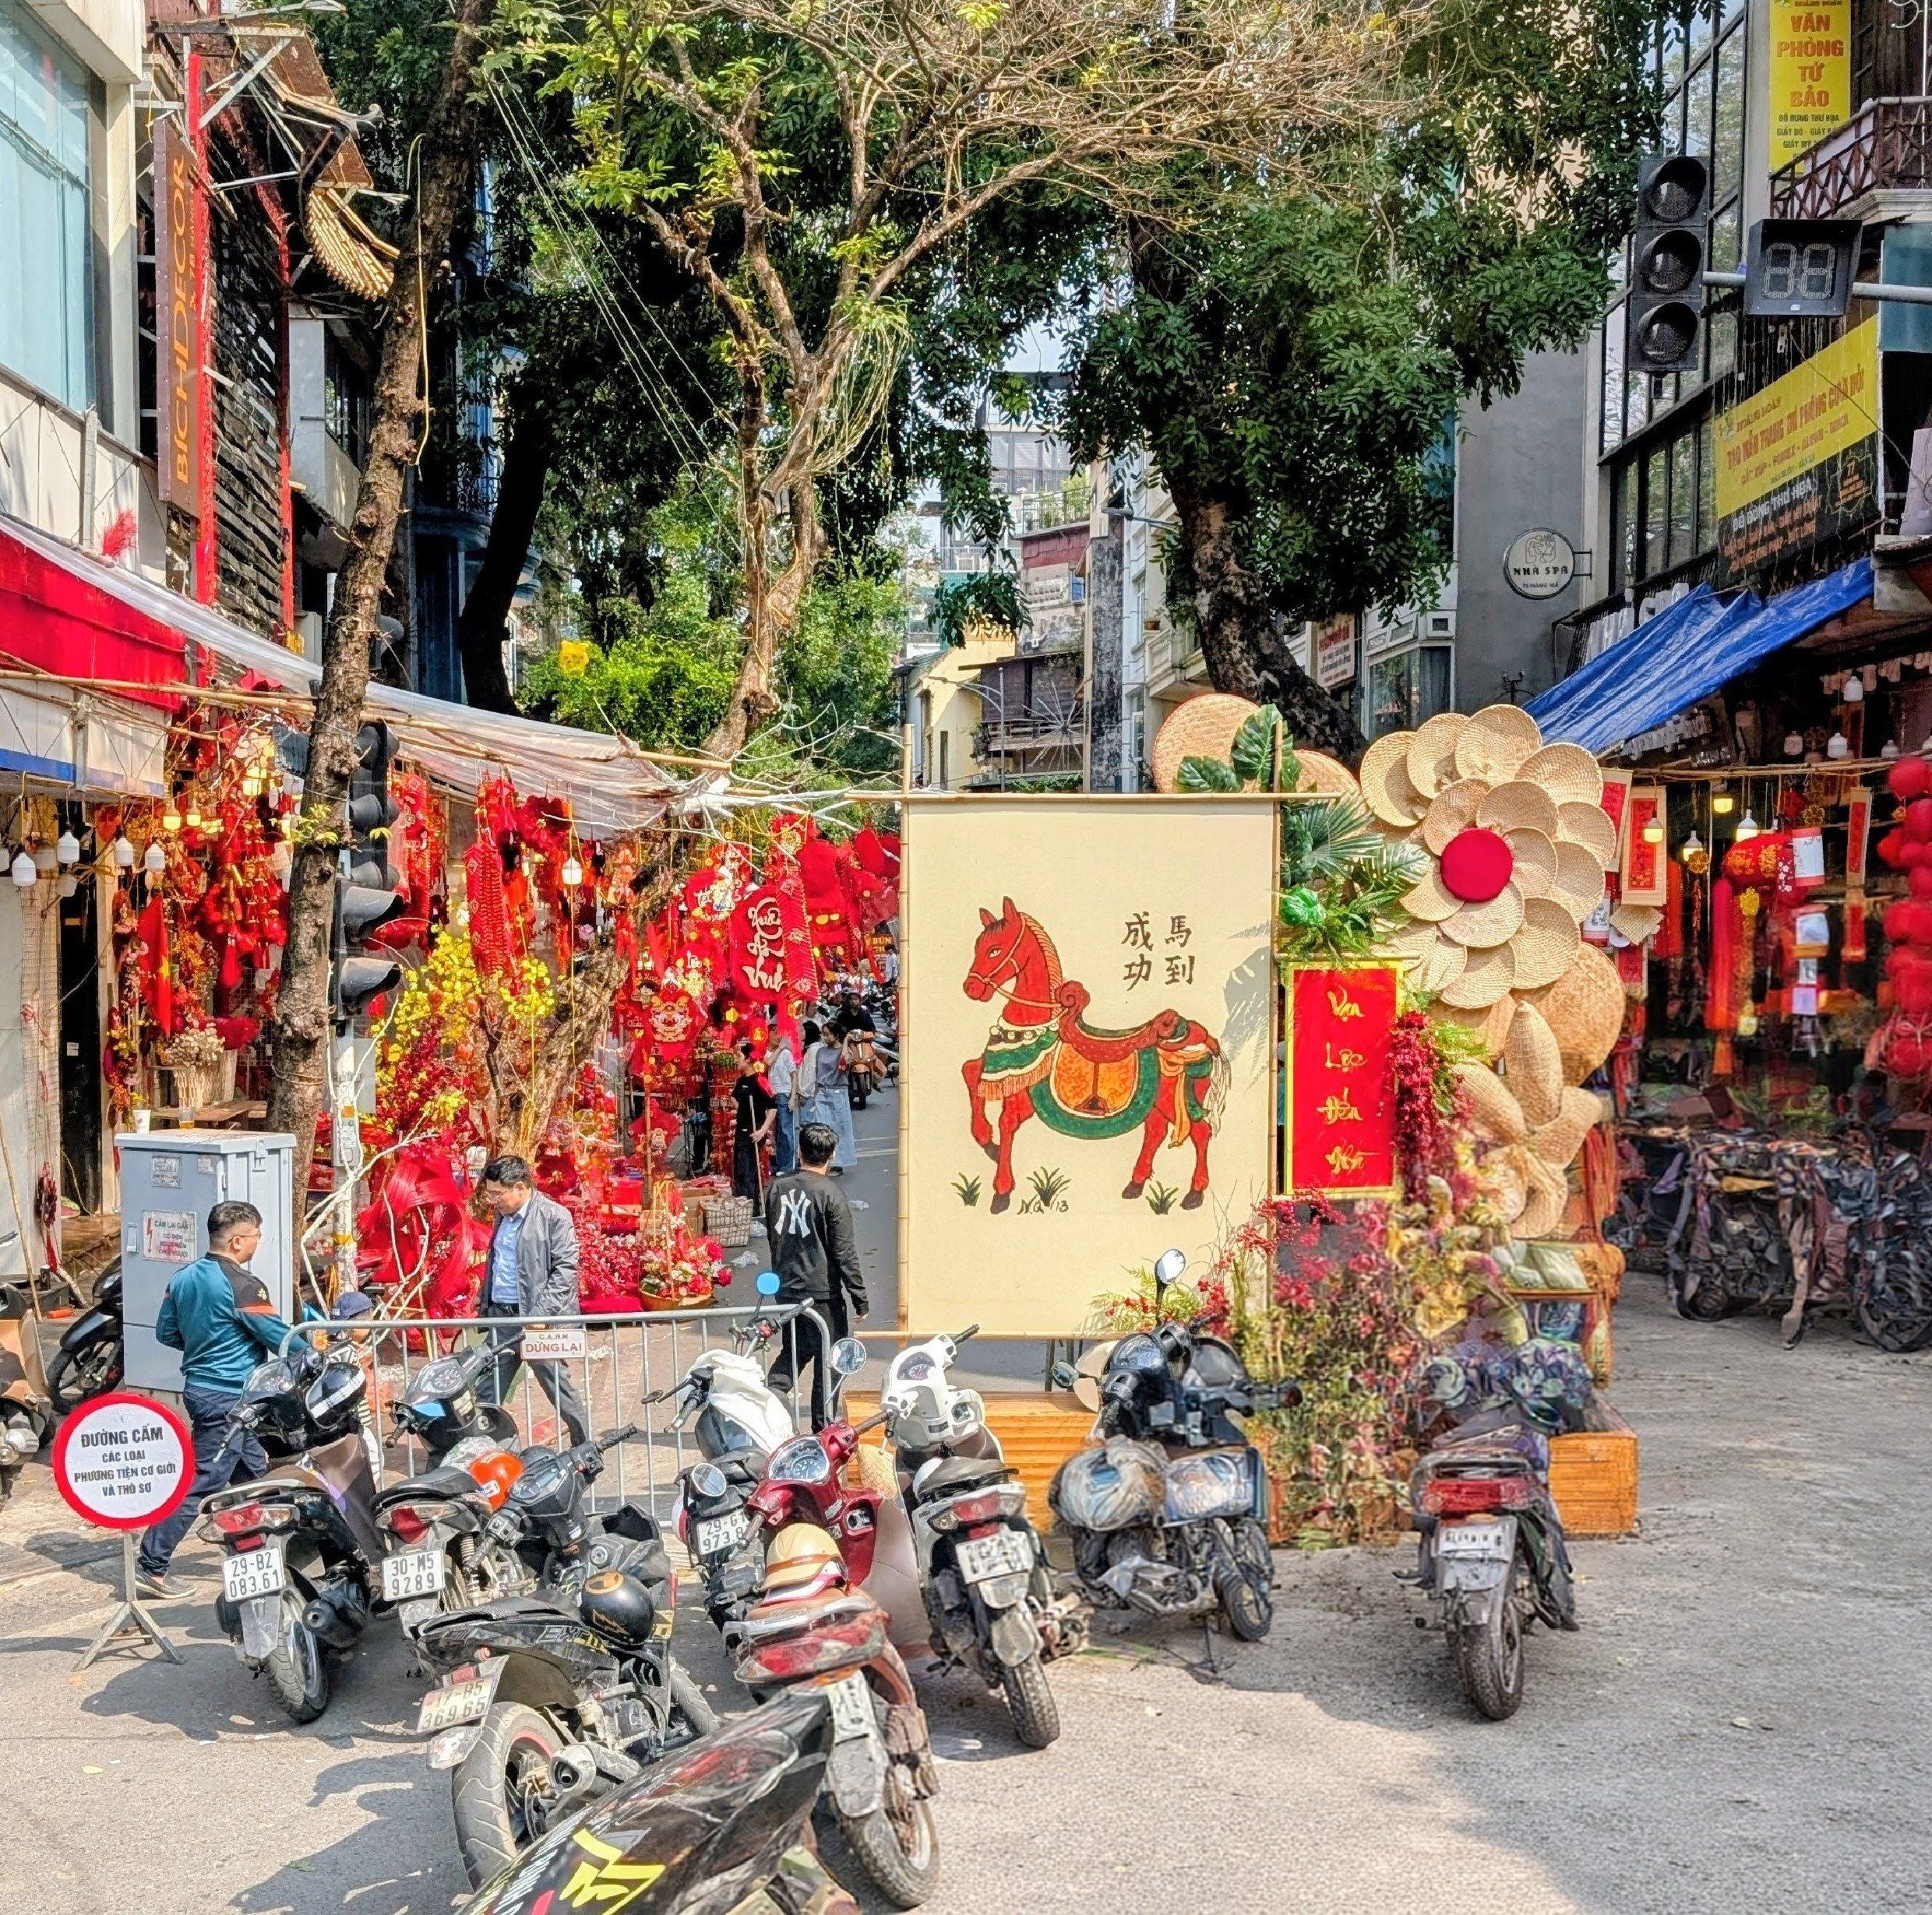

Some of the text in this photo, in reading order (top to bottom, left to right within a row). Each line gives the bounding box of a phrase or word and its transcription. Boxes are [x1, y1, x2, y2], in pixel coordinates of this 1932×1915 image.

[1790, 12, 1831, 33] VĂN
[1790, 85, 1830, 108] BẢO
[1121, 911, 1155, 992] 成功
[1164, 915, 1196, 986] 馬到
[1327, 983, 1365, 1022] Vạn
[774, 1188, 812, 1239] NY
[80, 1423, 164, 1448] ĐƯỜNG CẤM
[101, 1449, 146, 1463] CÁC LOẠI
[73, 1462, 176, 1483] PHƯƠNG TIỆN CƠ GIỚI
[102, 1481, 152, 1497] VÀ THÔ SƠ
[231, 1551, 273, 1577] 29-B2
[391, 1552, 435, 1577] 30-M5
[229, 1569, 280, 1598] 083.61
[391, 1574, 435, 1596] 9289
